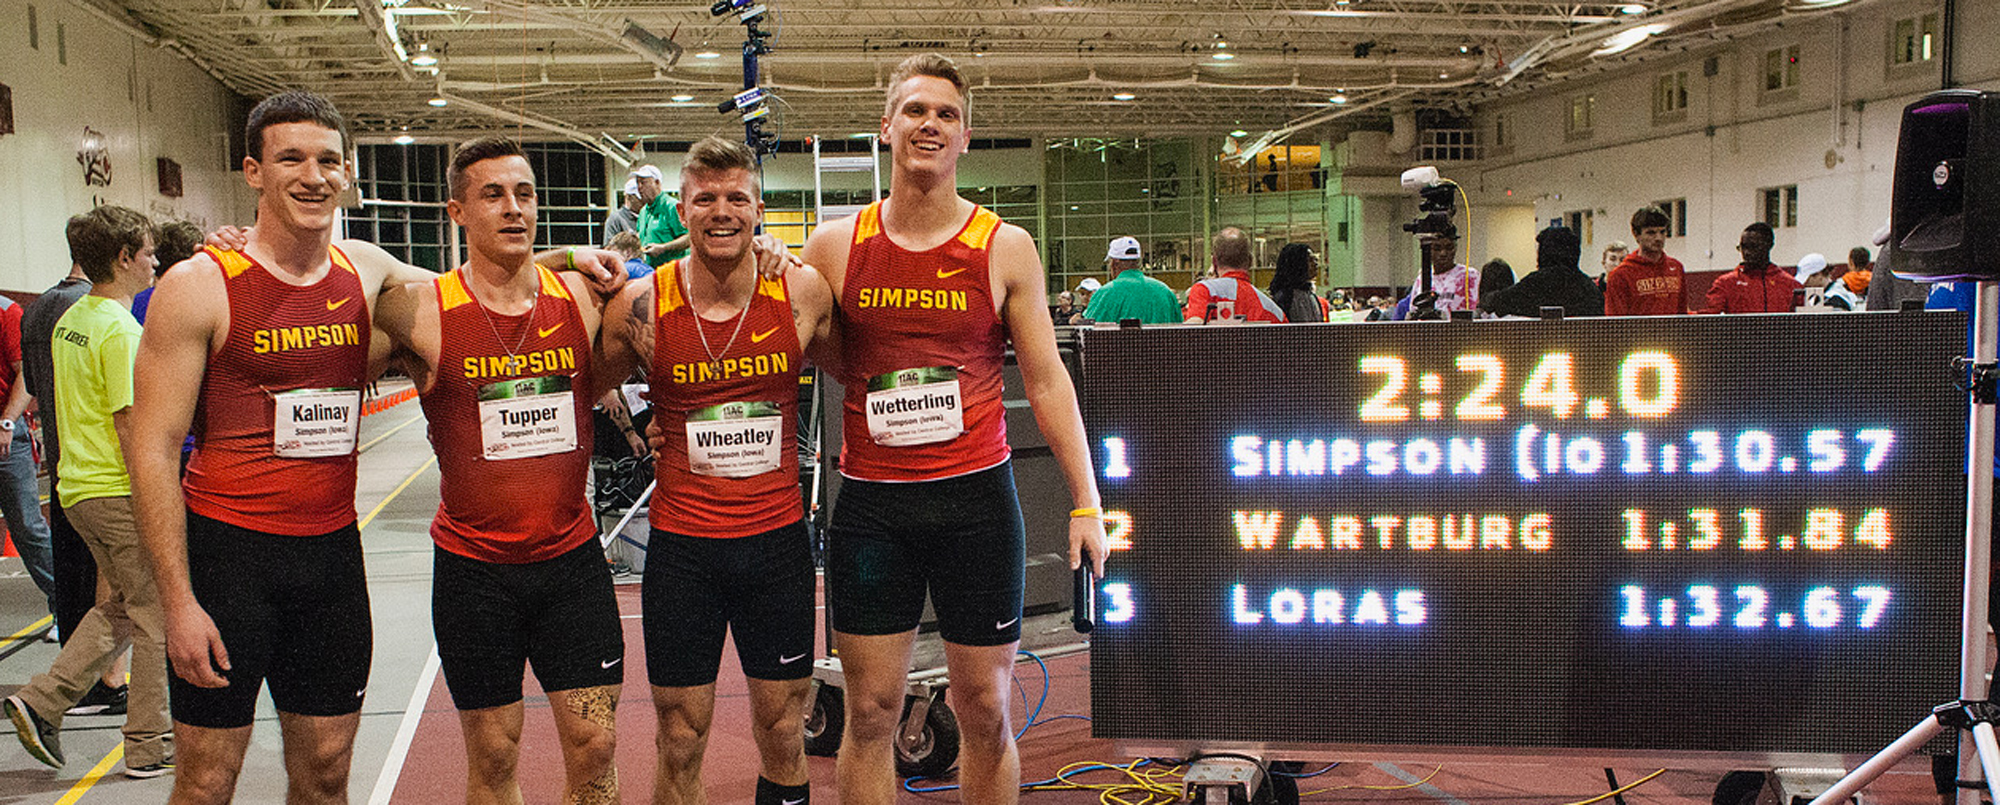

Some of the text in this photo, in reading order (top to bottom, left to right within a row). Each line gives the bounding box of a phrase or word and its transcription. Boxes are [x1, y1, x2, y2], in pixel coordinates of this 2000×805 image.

[858, 288, 968, 311] SIMPSON
[253, 323, 359, 354] SIMPSON
[463, 347, 576, 379] SIMPSON
[672, 352, 788, 384] SIMPSON
[1358, 350, 1682, 422] 2:24.0
[292, 403, 350, 423] Kalinay
[871, 393, 955, 415] Wetterling
[498, 407, 558, 427] Tupper
[886, 414, 944, 428] Simpson (Iowa)
[295, 427, 328, 437] Simpson
[501, 426, 559, 439] Simpson (Iowa)
[696, 428, 774, 447] Wheatley
[707, 448, 765, 460] Simpson (Iowa)
[1103, 436, 1132, 478] 1
[1230, 435, 1487, 478] SIMPSON
[1620, 428, 1896, 474] 1:30.57
[1104, 508, 1893, 552] 2 WARTBURG 1:31.84
[1103, 582, 1892, 628] 3 LORAS 1:32.67
